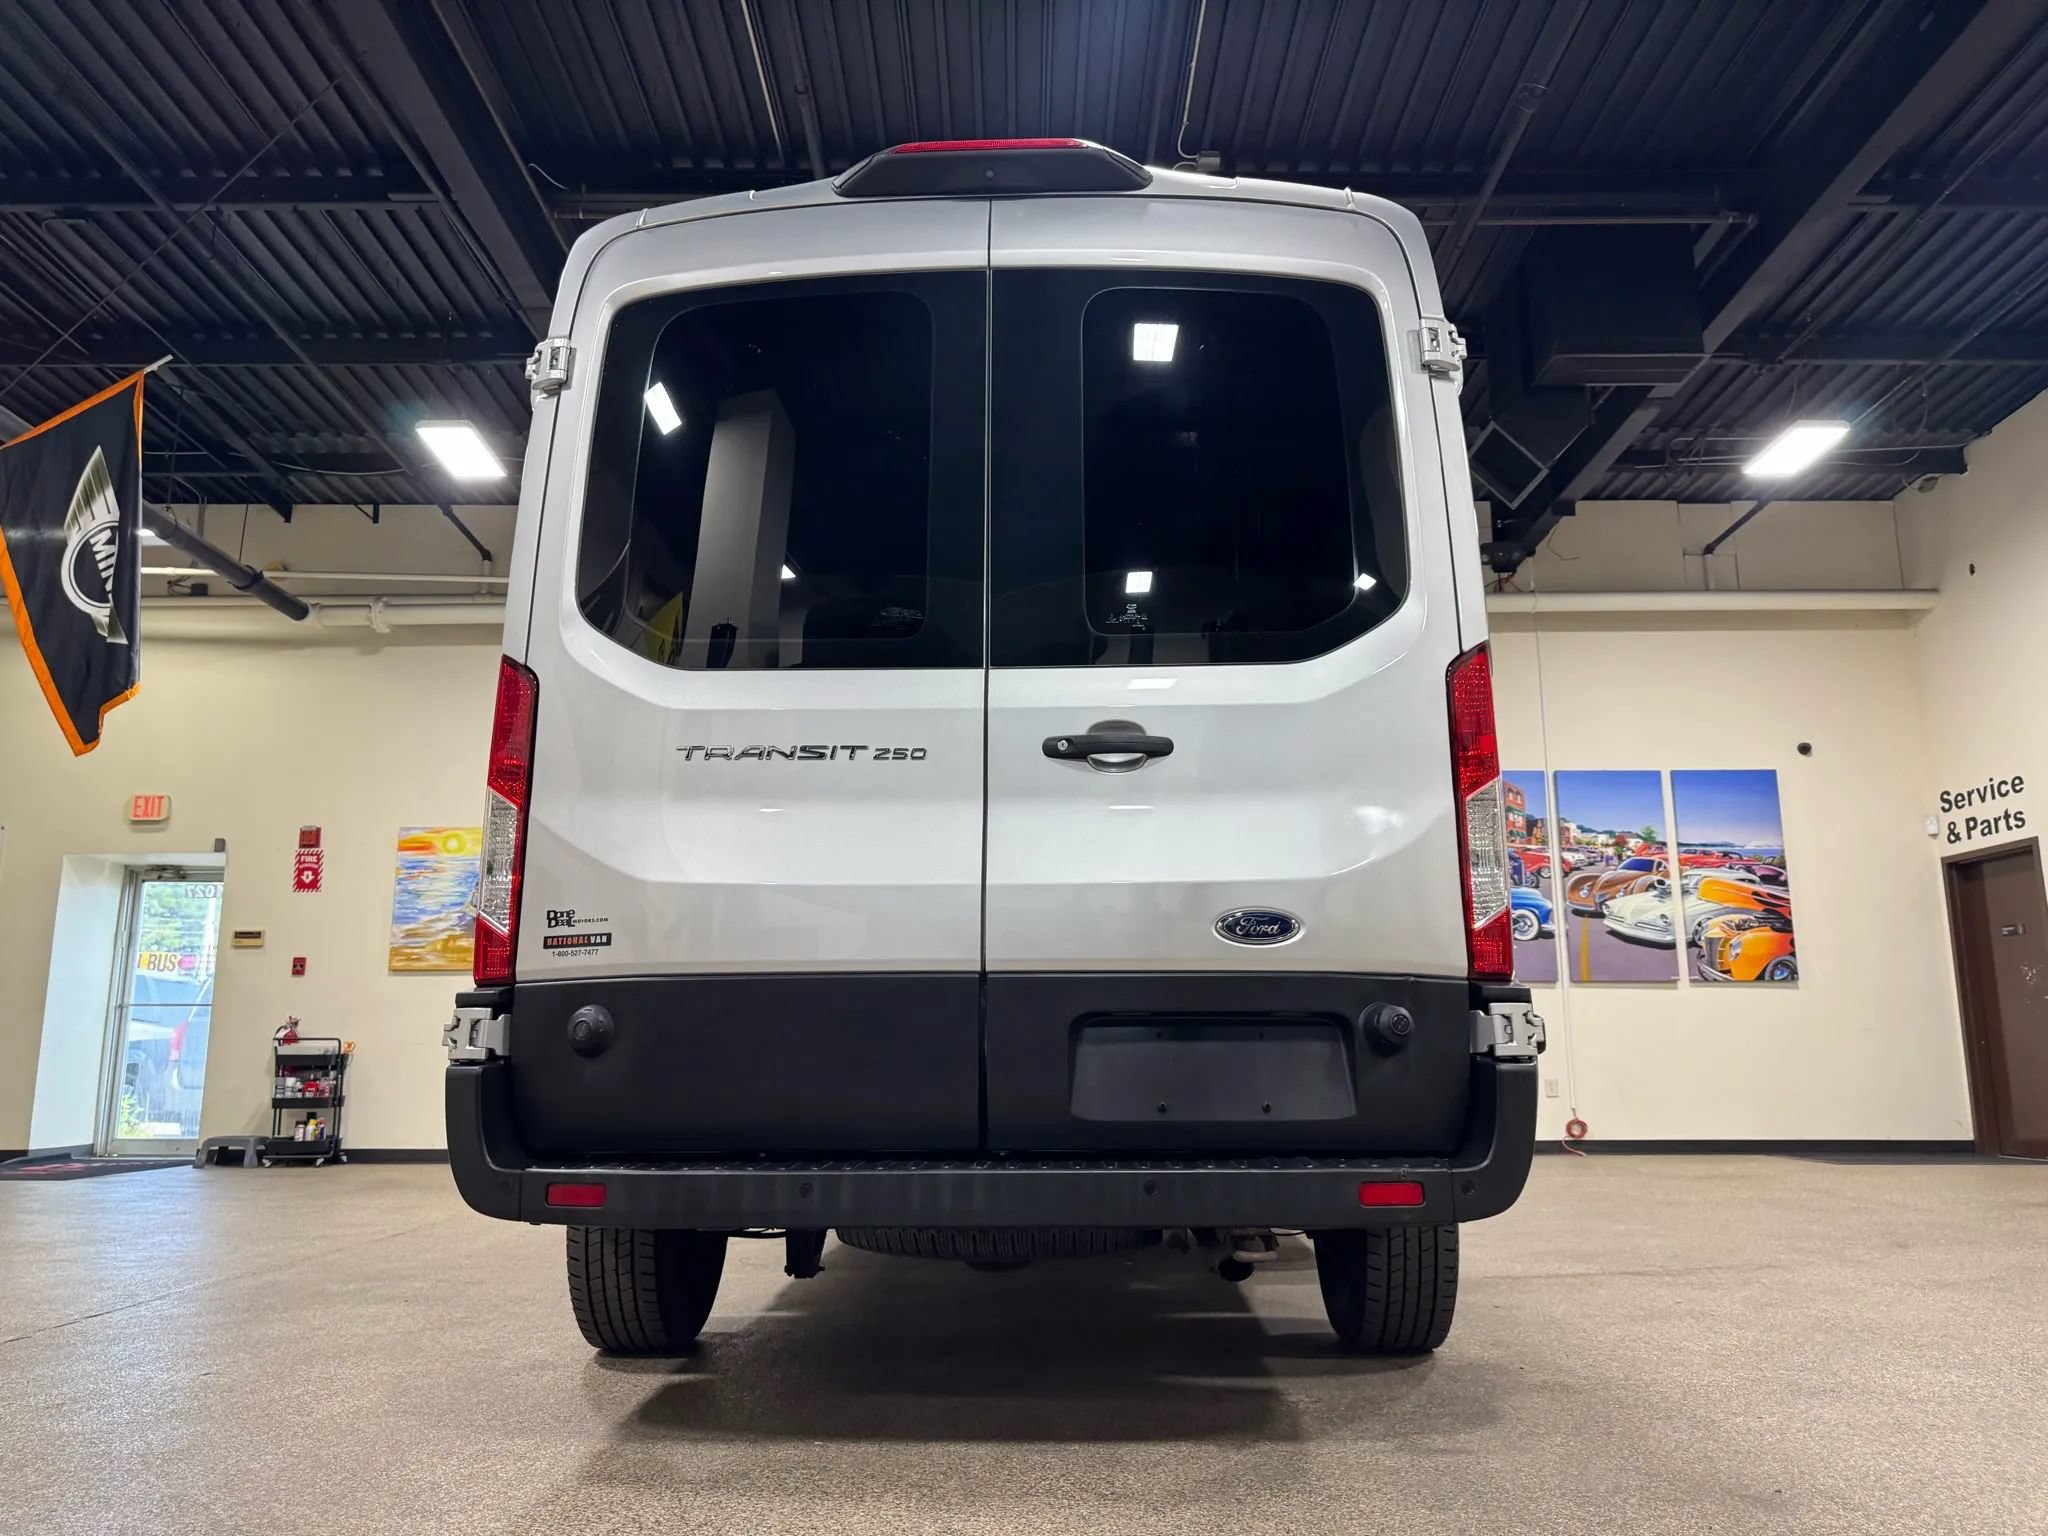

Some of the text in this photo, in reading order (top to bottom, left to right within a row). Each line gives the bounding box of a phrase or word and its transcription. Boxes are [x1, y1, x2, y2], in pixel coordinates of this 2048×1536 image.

[676, 745, 927, 761] TRANSIT 250
[1940, 775, 2025, 813] Service
[132, 795, 165, 818] EXIT
[1946, 807, 2026, 844] & Parts
[1236, 916, 1281, 935] Ford
[546, 935, 607, 946] NATIONAL VAN
[147, 953, 178, 972] BUS
